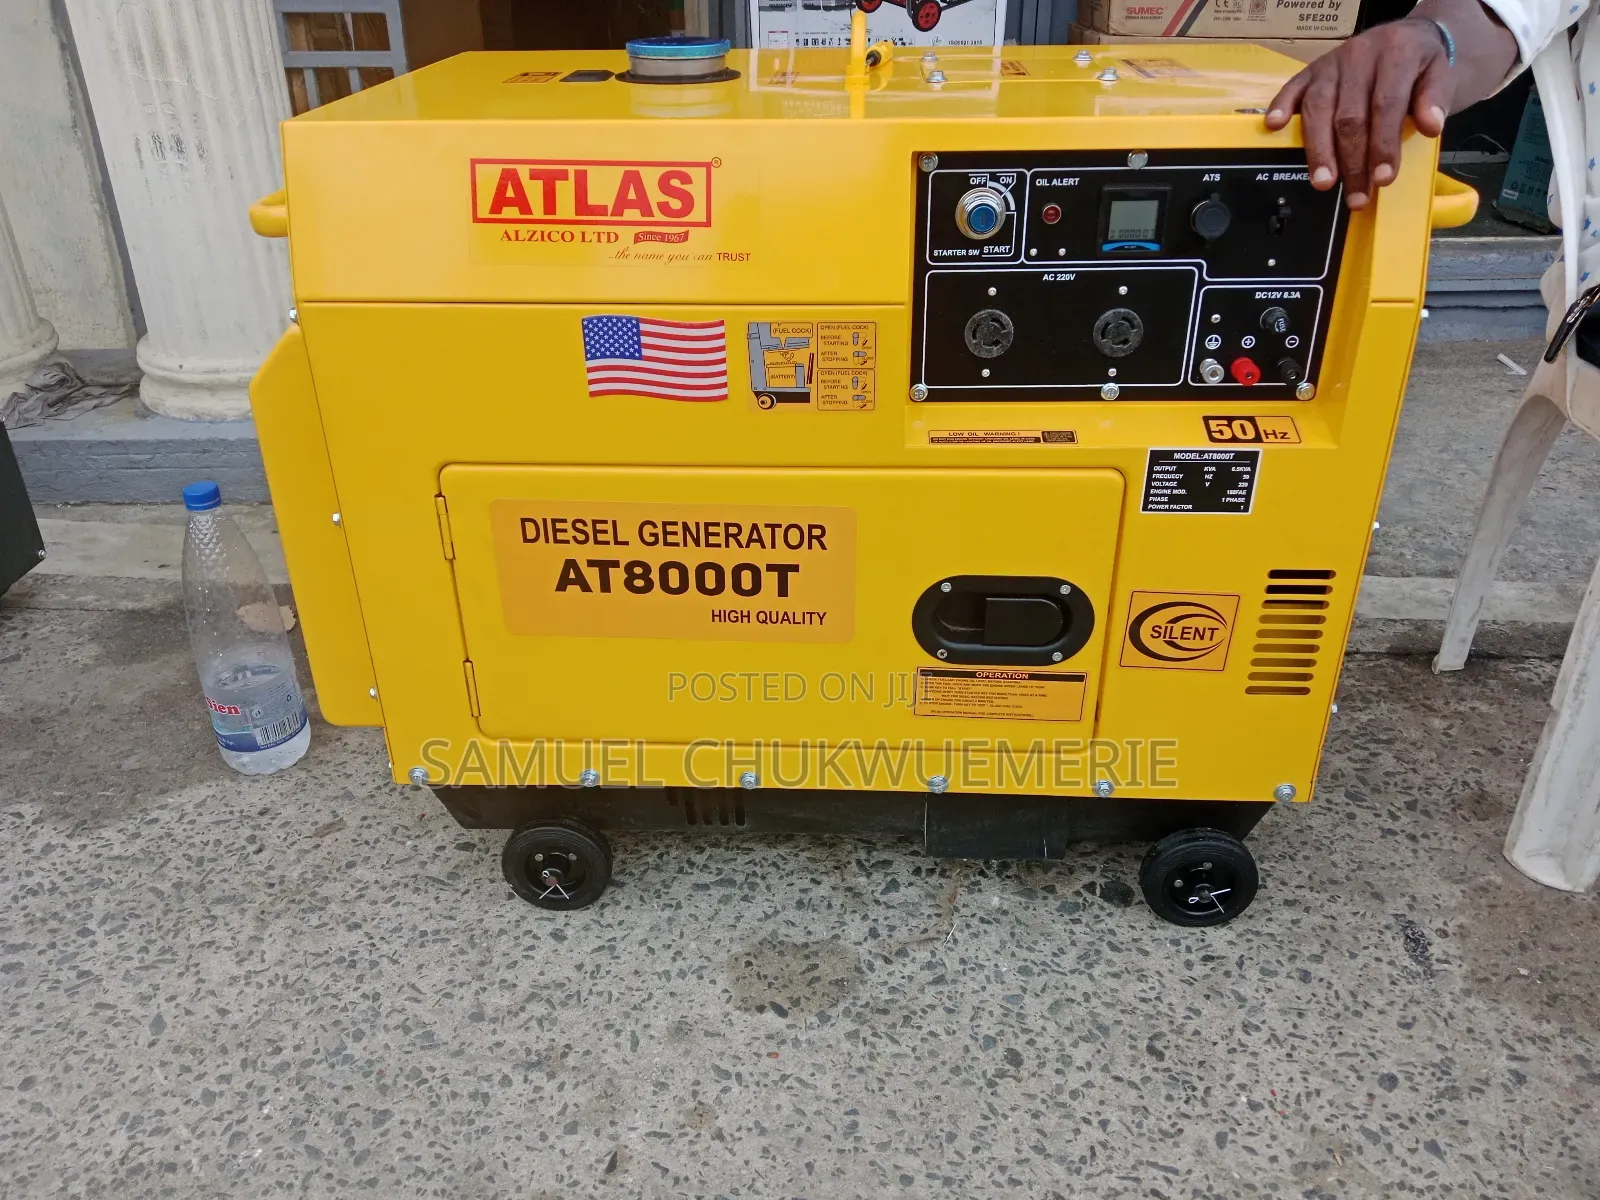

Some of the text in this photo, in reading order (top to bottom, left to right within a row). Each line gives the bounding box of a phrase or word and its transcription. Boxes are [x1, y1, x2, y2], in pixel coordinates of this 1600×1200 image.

[1126, 6, 1164, 15] SUMEC
[1298, 13, 1339, 22] SFE200
[969, 176, 988, 185] OFF
[999, 176, 1013, 185] ON
[1203, 173, 1221, 182] ATS
[1255, 172, 1310, 181] AC BREAKE
[1035, 177, 1080, 186] OIL ALERT
[488, 167, 695, 219] ATLAS
[500, 229, 620, 244] ALZICO LTD
[638, 231, 685, 243] Since 1967
[933, 249, 966, 257] STARTER
[983, 245, 1010, 254] START
[633, 252, 665, 261] name
[664, 252, 690, 265] you
[716, 252, 751, 262] TRUST
[1042, 273, 1055, 281] AC
[1254, 291, 1301, 299] DC12V 8.3A
[1208, 419, 1256, 440] 50
[1262, 429, 1291, 440] Hz
[520, 517, 828, 551] DIESEL GENERATOR
[554, 558, 801, 598] AT8000T
[710, 609, 827, 626] HIGH QUALITY
[1149, 623, 1221, 644] SILENT
[975, 672, 1029, 680] OPERATION
